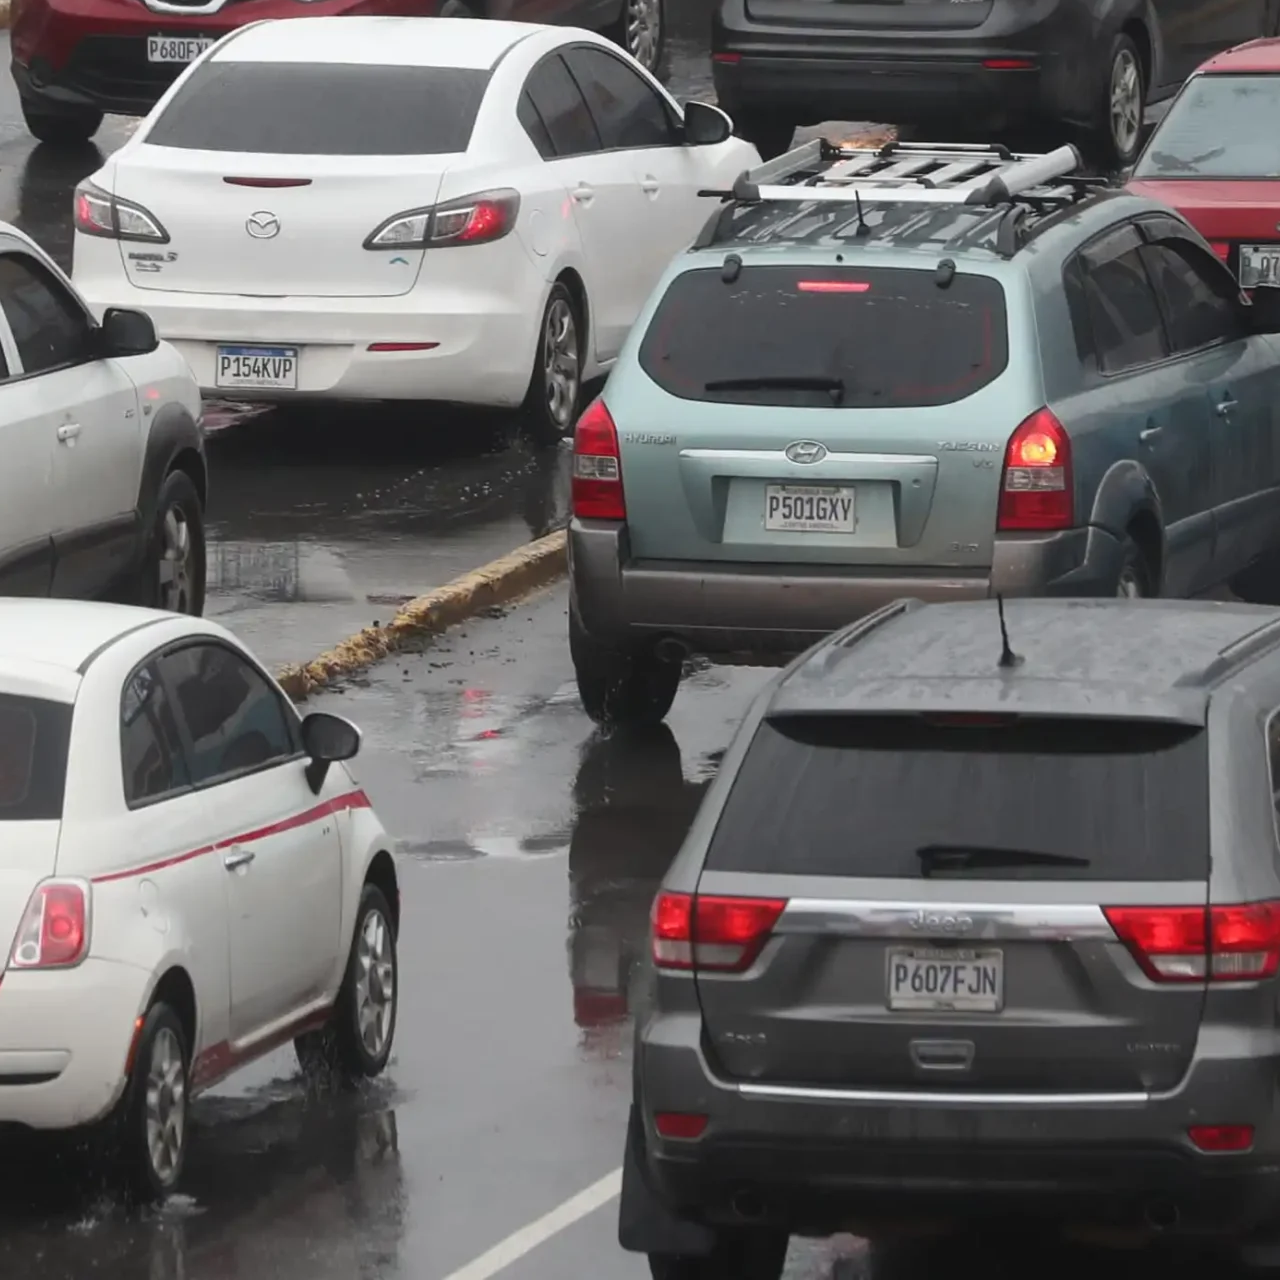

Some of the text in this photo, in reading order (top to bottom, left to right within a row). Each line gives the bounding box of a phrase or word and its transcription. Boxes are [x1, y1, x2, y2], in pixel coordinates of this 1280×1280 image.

[221, 356, 293, 379] P154KVP
[769, 495, 852, 521] P501GXY
[908, 909, 974, 936] Jeep
[894, 963, 997, 995] P607FJN
